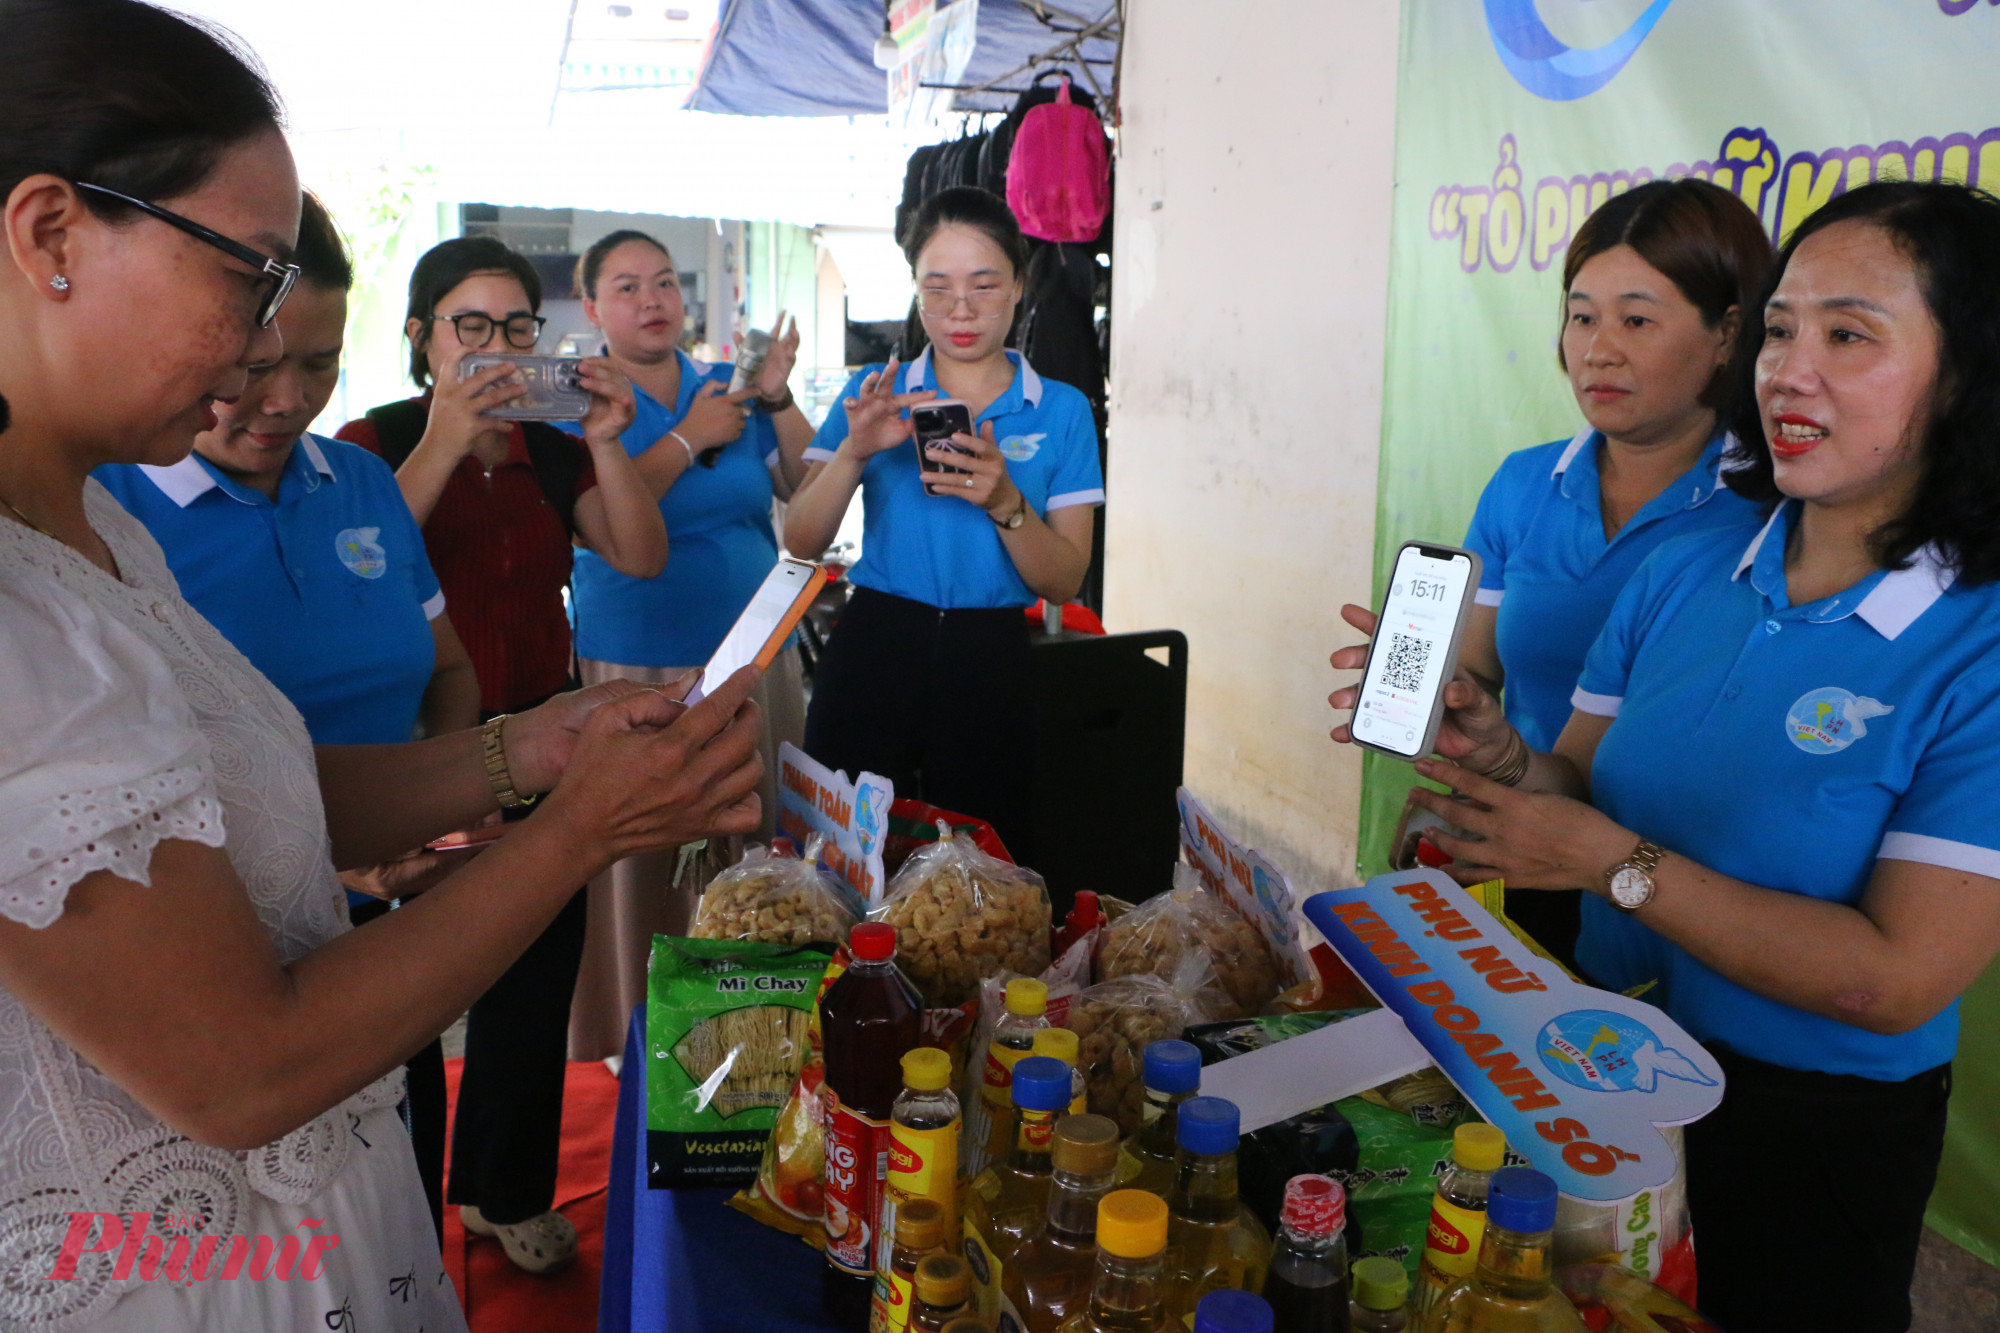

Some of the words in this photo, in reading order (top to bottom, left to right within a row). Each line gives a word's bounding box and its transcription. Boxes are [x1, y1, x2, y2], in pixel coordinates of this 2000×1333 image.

[1410, 580, 1446, 602] 15:11
[782, 760, 818, 806] THANH
[818, 785, 851, 832] TOÁN
[1391, 881, 1484, 943] PHỤ
[1457, 944, 1549, 995] NỮ
[717, 976, 748, 992] Mì
[753, 976, 809, 994] Chay
[1330, 901, 1432, 978] KINH
[1405, 979, 1561, 1114] DOANH
[1534, 1116, 1641, 1177] SỐ
[1578, 1057, 1598, 1079] NAM
[1626, 1191, 1651, 1233] Cao
